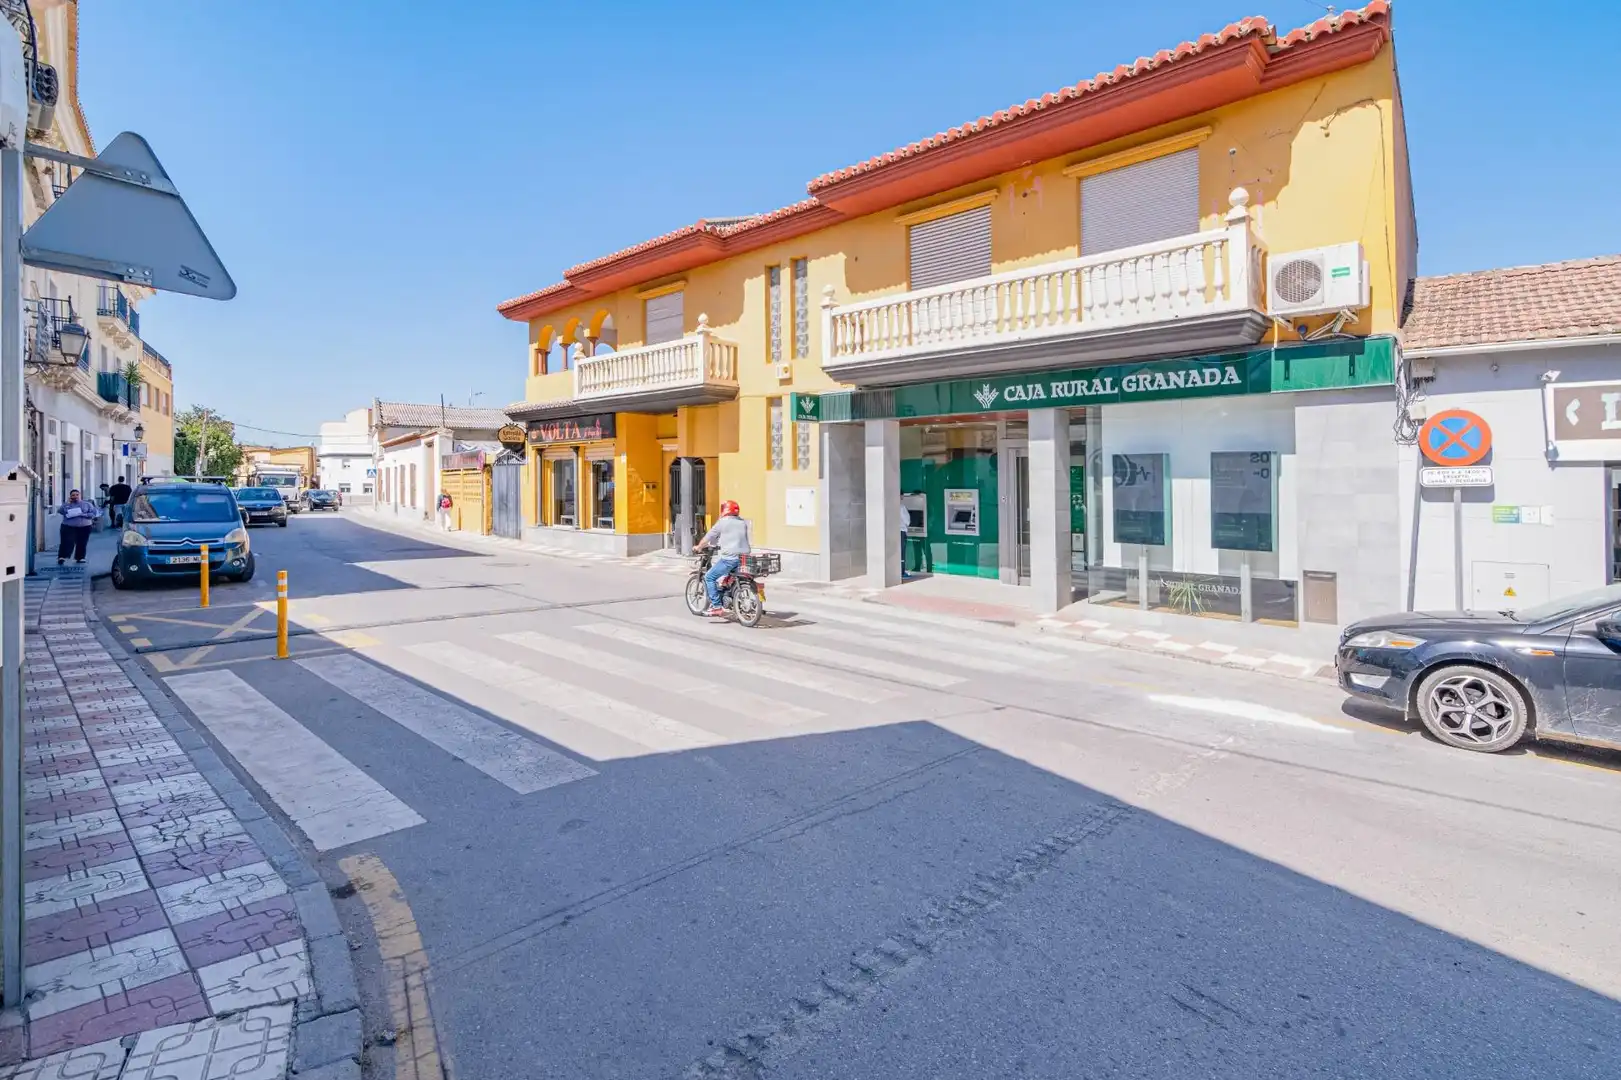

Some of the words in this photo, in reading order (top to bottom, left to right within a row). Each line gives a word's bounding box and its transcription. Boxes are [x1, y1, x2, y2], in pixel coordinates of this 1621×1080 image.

[1003, 383, 1047, 401] CAJA
[1050, 377, 1119, 398] RURAL
[1121, 366, 1242, 392] GRANADA
[540, 421, 581, 440] VOLTA
